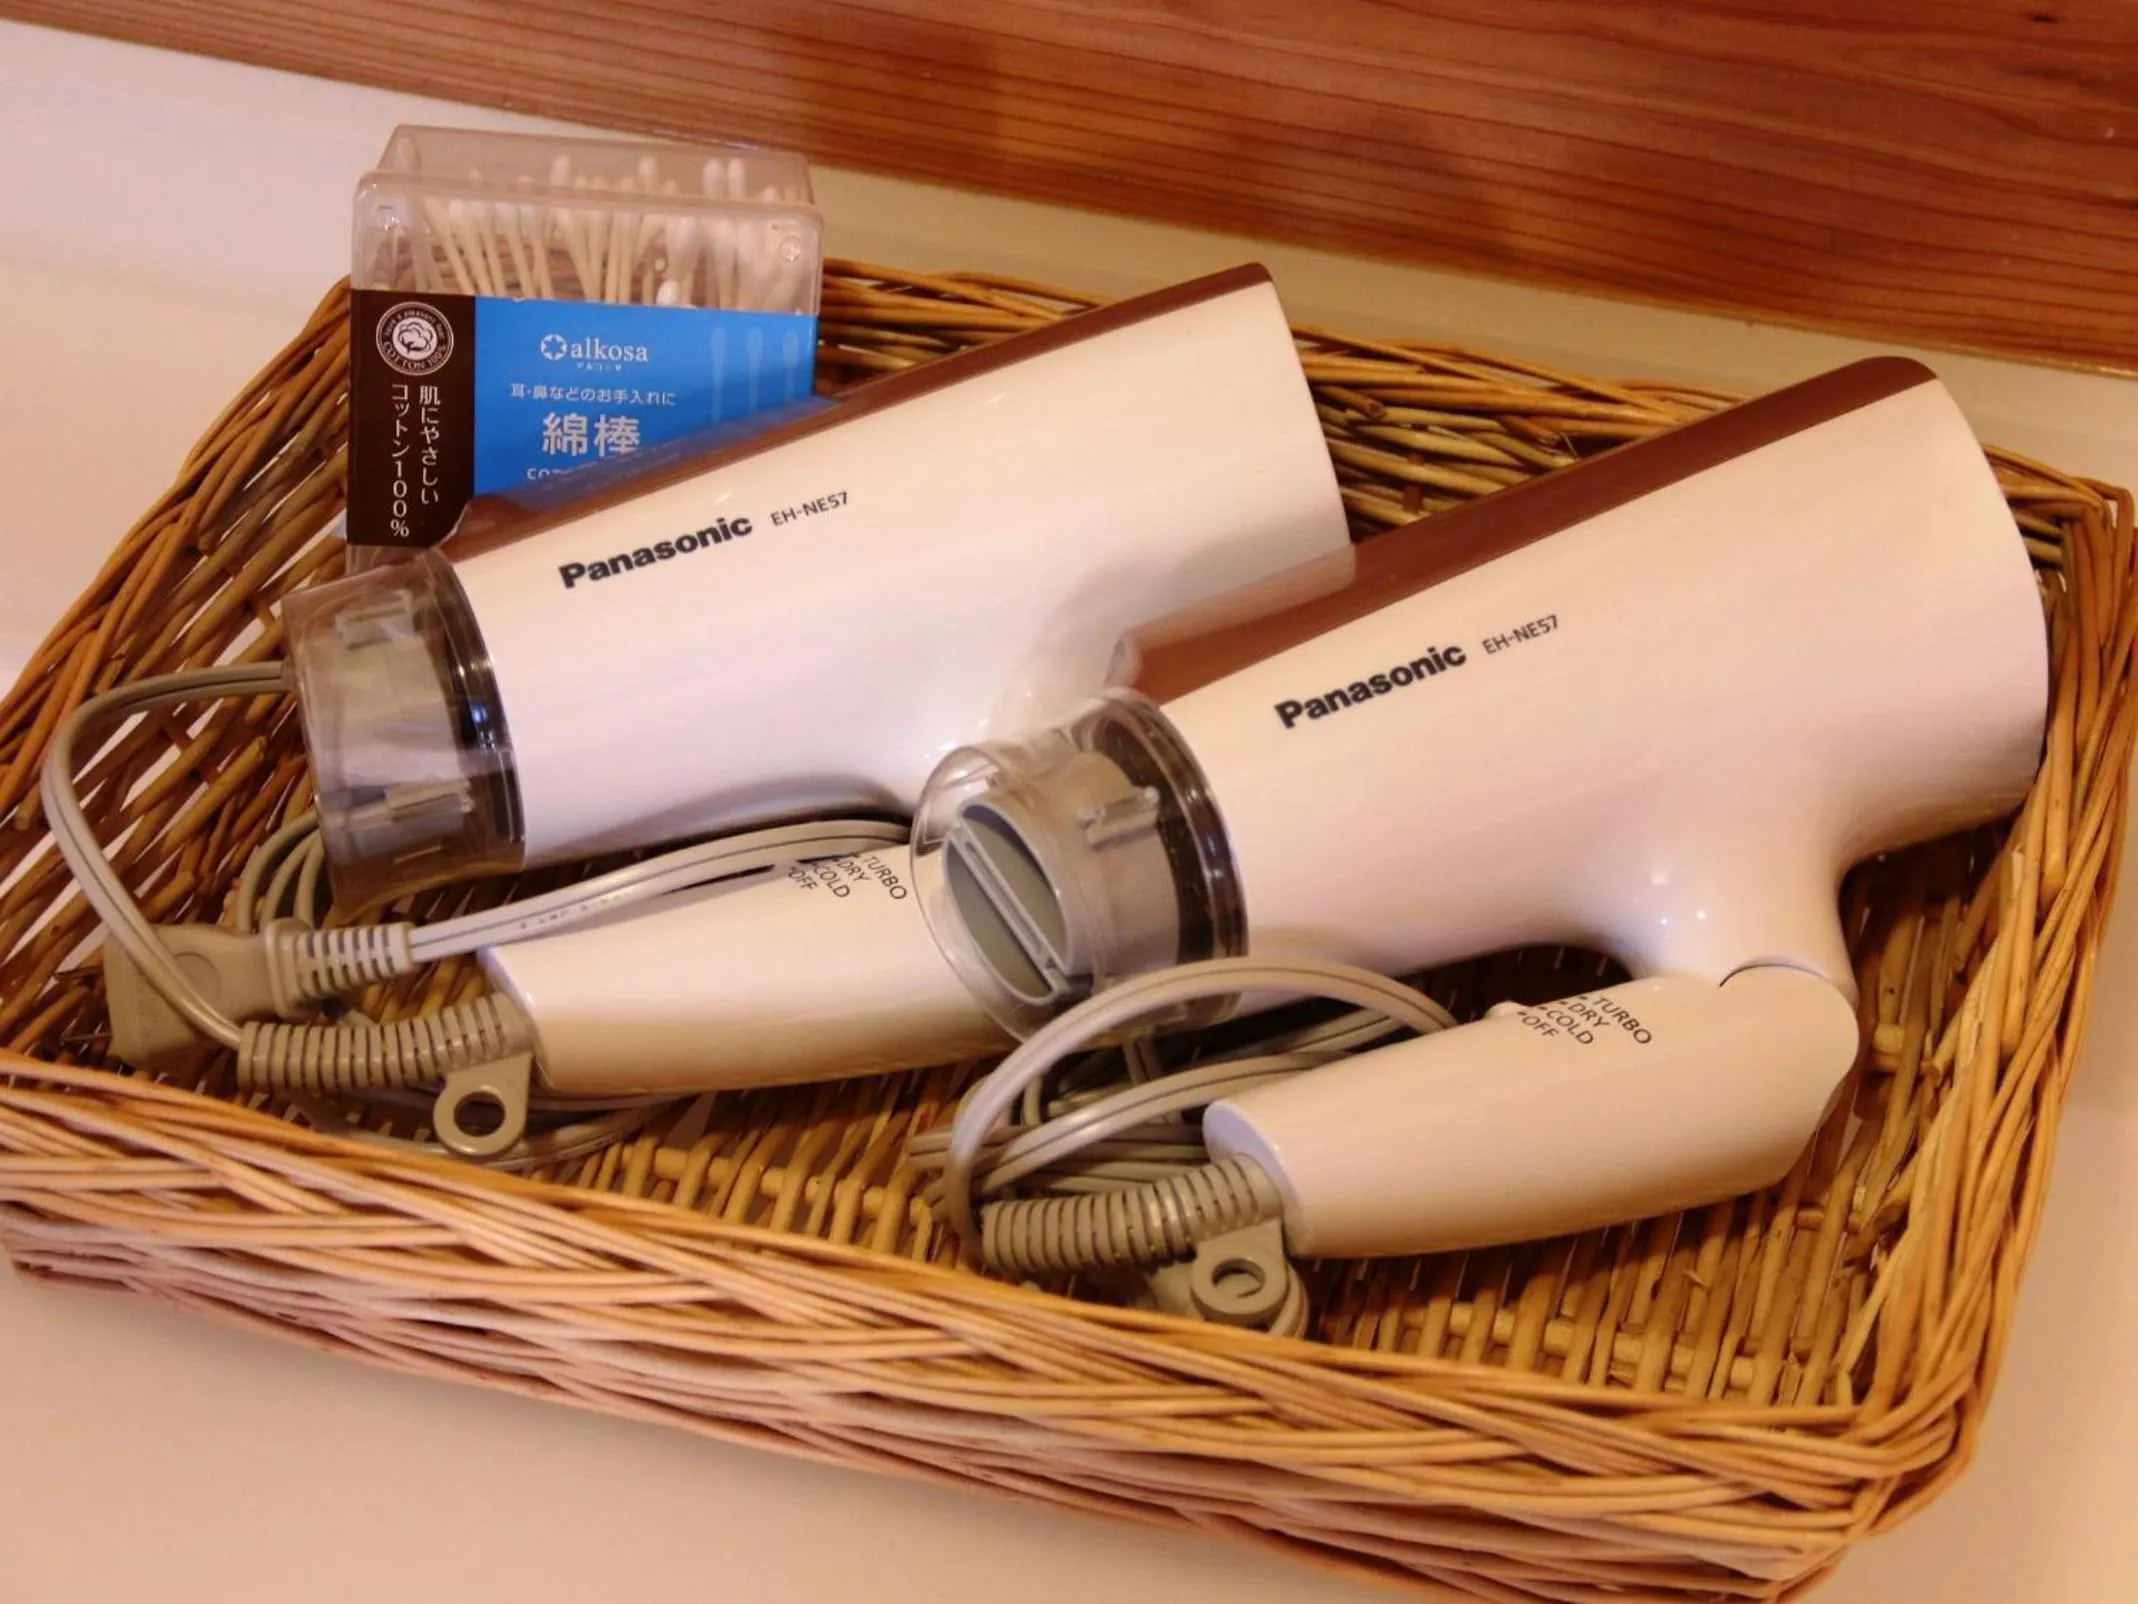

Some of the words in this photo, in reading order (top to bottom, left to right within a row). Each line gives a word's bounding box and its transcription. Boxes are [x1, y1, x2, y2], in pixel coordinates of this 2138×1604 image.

[570, 336, 649, 362] alkosa
[420, 385, 440, 504] 肌にやさしい
[542, 412, 640, 456] 綿棒
[558, 517, 753, 589] Panasonic
[770, 491, 849, 527] EH-NE57
[1274, 645, 1467, 729] Panasonic
[1482, 614, 1559, 655] EH-NE57
[788, 866, 819, 891] OFF
[813, 863, 851, 899] COLD
[837, 859, 873, 883] DRY
[862, 855, 908, 900] TURBO
[1521, 1015, 1559, 1038] OFF
[1546, 1010, 1594, 1045] COLD
[1568, 1002, 1610, 1029] DRY
[1593, 997, 1652, 1045] TURBO
